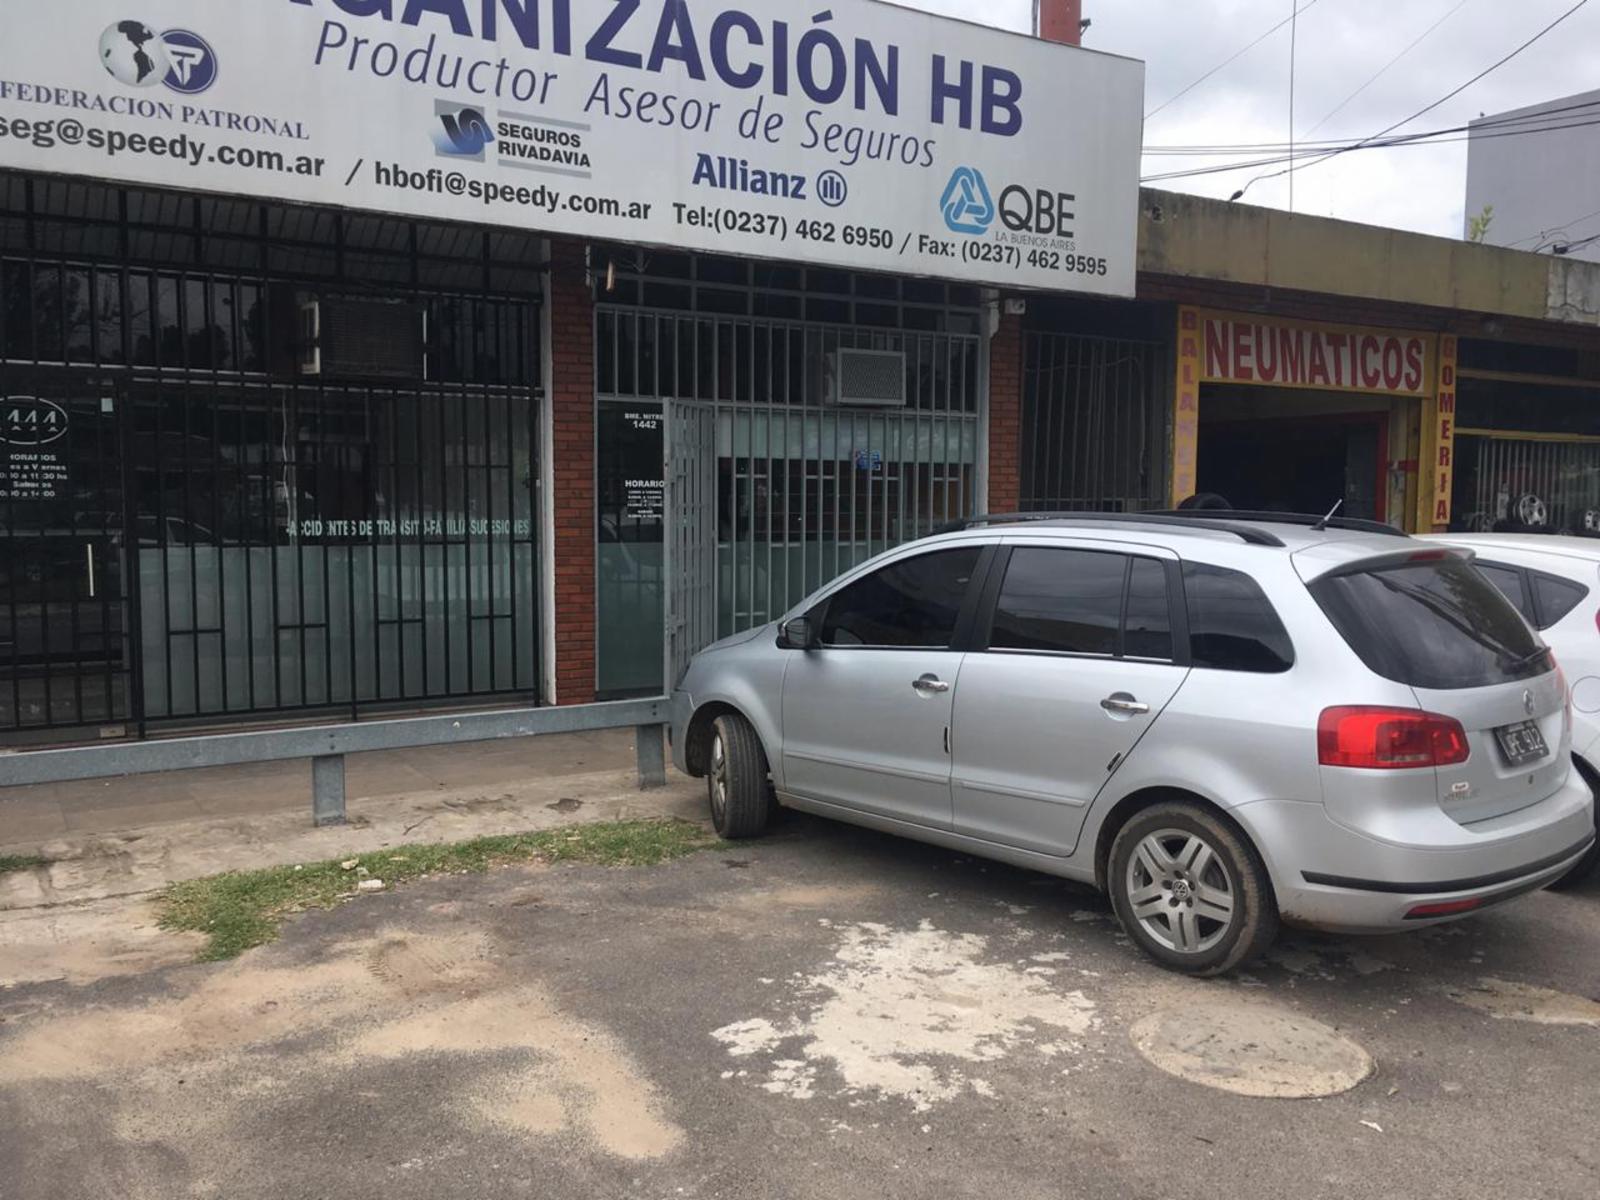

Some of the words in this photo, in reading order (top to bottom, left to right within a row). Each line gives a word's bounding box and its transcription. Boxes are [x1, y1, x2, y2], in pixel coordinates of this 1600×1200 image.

[1, 81, 173, 120] FEDERACION
[181, 105, 310, 140] PATRONAL
[314, 20, 558, 104] Productor
[583, 72, 720, 133] Asesor
[738, 95, 784, 143] de
[800, 110, 936, 168] Seguros
[930, 54, 1023, 137] HB
[497, 122, 581, 148] SEGUROS
[498, 140, 591, 168] RIVADAVIA
[692, 152, 807, 200] Allianz
[345, 158, 363, 186] /
[375, 161, 651, 220] hbofi@speedy.com.ar
[795, 219, 836, 243] 462
[842, 225, 894, 249] 6950
[899, 233, 911, 255] /
[918, 235, 955, 257] Fax:
[962, 240, 1021, 269] (0237)
[1027, 249, 1060, 270] 462
[1065, 254, 1107, 276] 9595
[998, 184, 1076, 238] QBE
[995, 231, 1009, 242] LA
[1010, 232, 1048, 249] BUENOS
[1049, 238, 1076, 252] AIRES
[1205, 319, 1423, 392] NEUMATICOS
[633, 420, 657, 429] 1442
[1436, 337, 1457, 520] GOMERIA
[359, 520, 373, 536] DE
